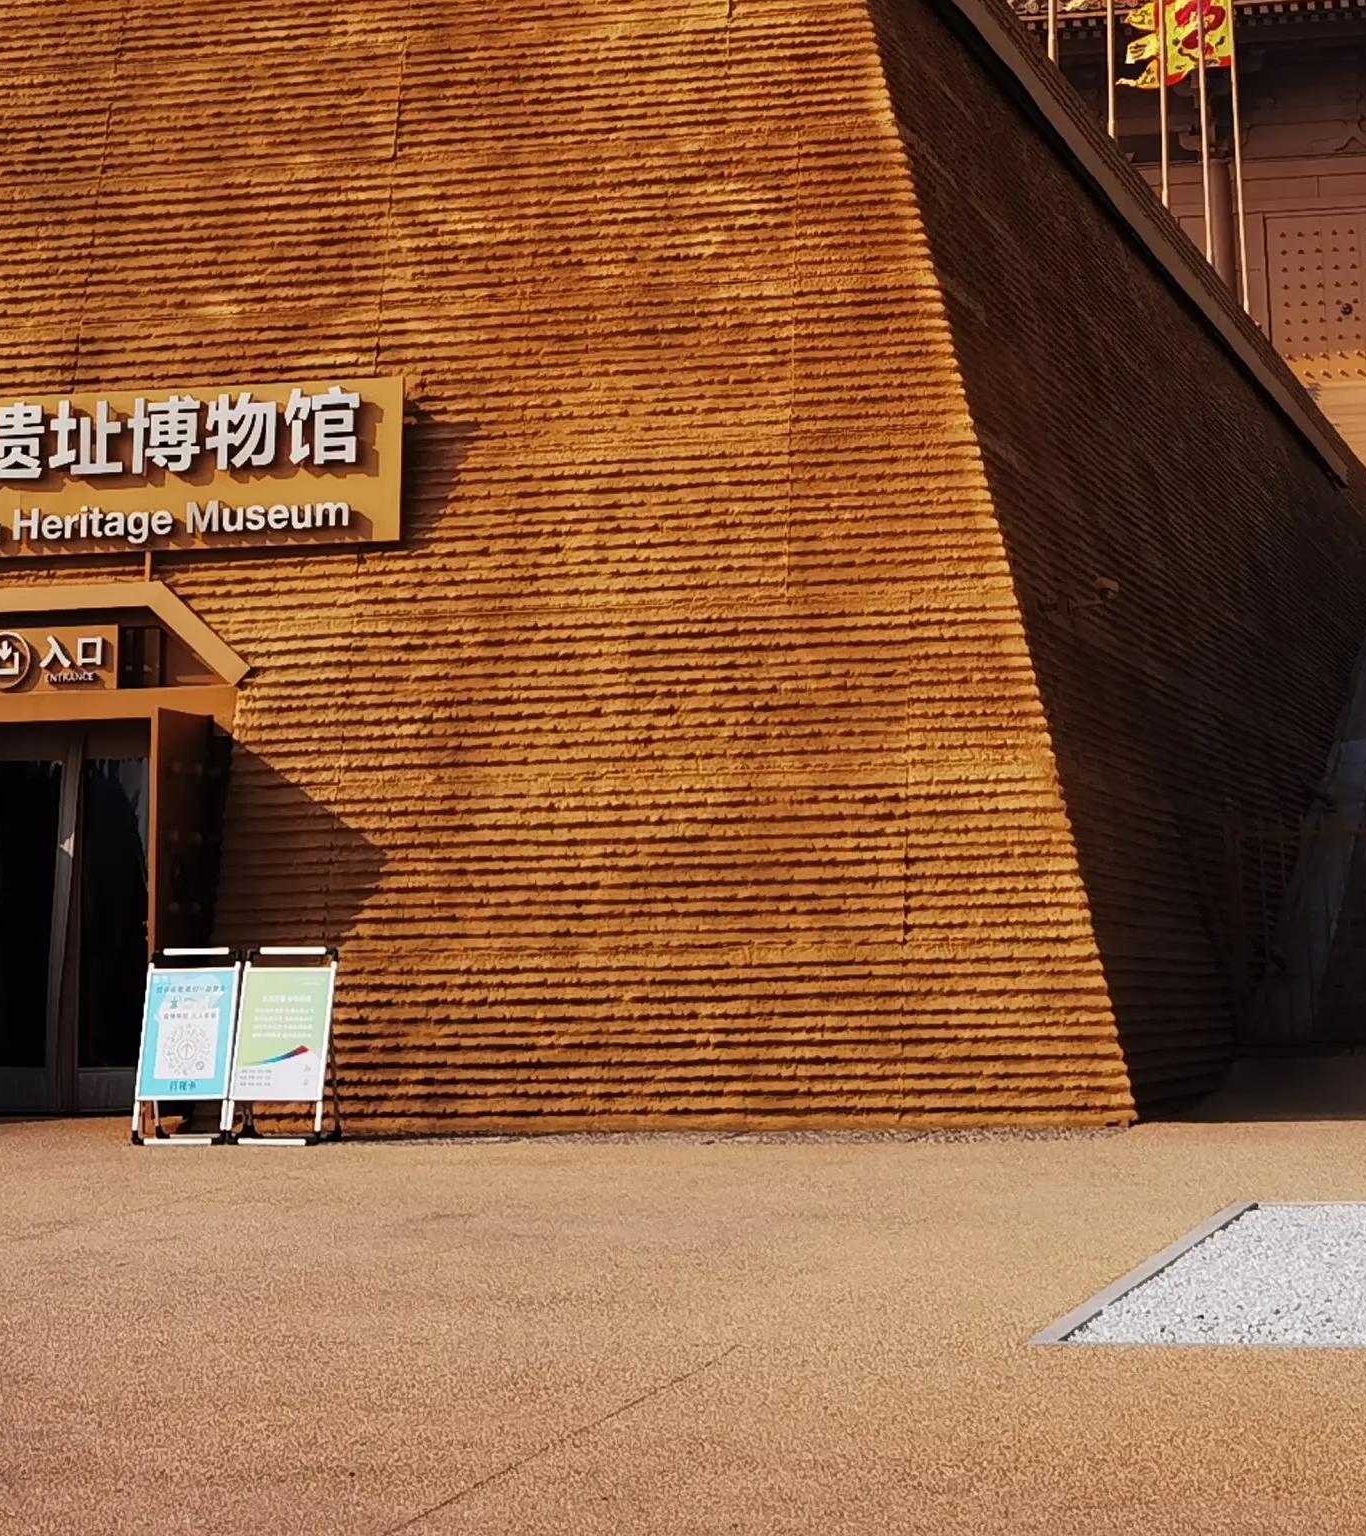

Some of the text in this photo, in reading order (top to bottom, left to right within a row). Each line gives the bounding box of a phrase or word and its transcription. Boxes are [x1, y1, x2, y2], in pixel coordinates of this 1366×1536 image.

[11, 505, 174, 544] Heritage
[186, 499, 351, 534] Museum
[39, 635, 103, 668] 入口
[44, 671, 95, 683] ENTRANCE
